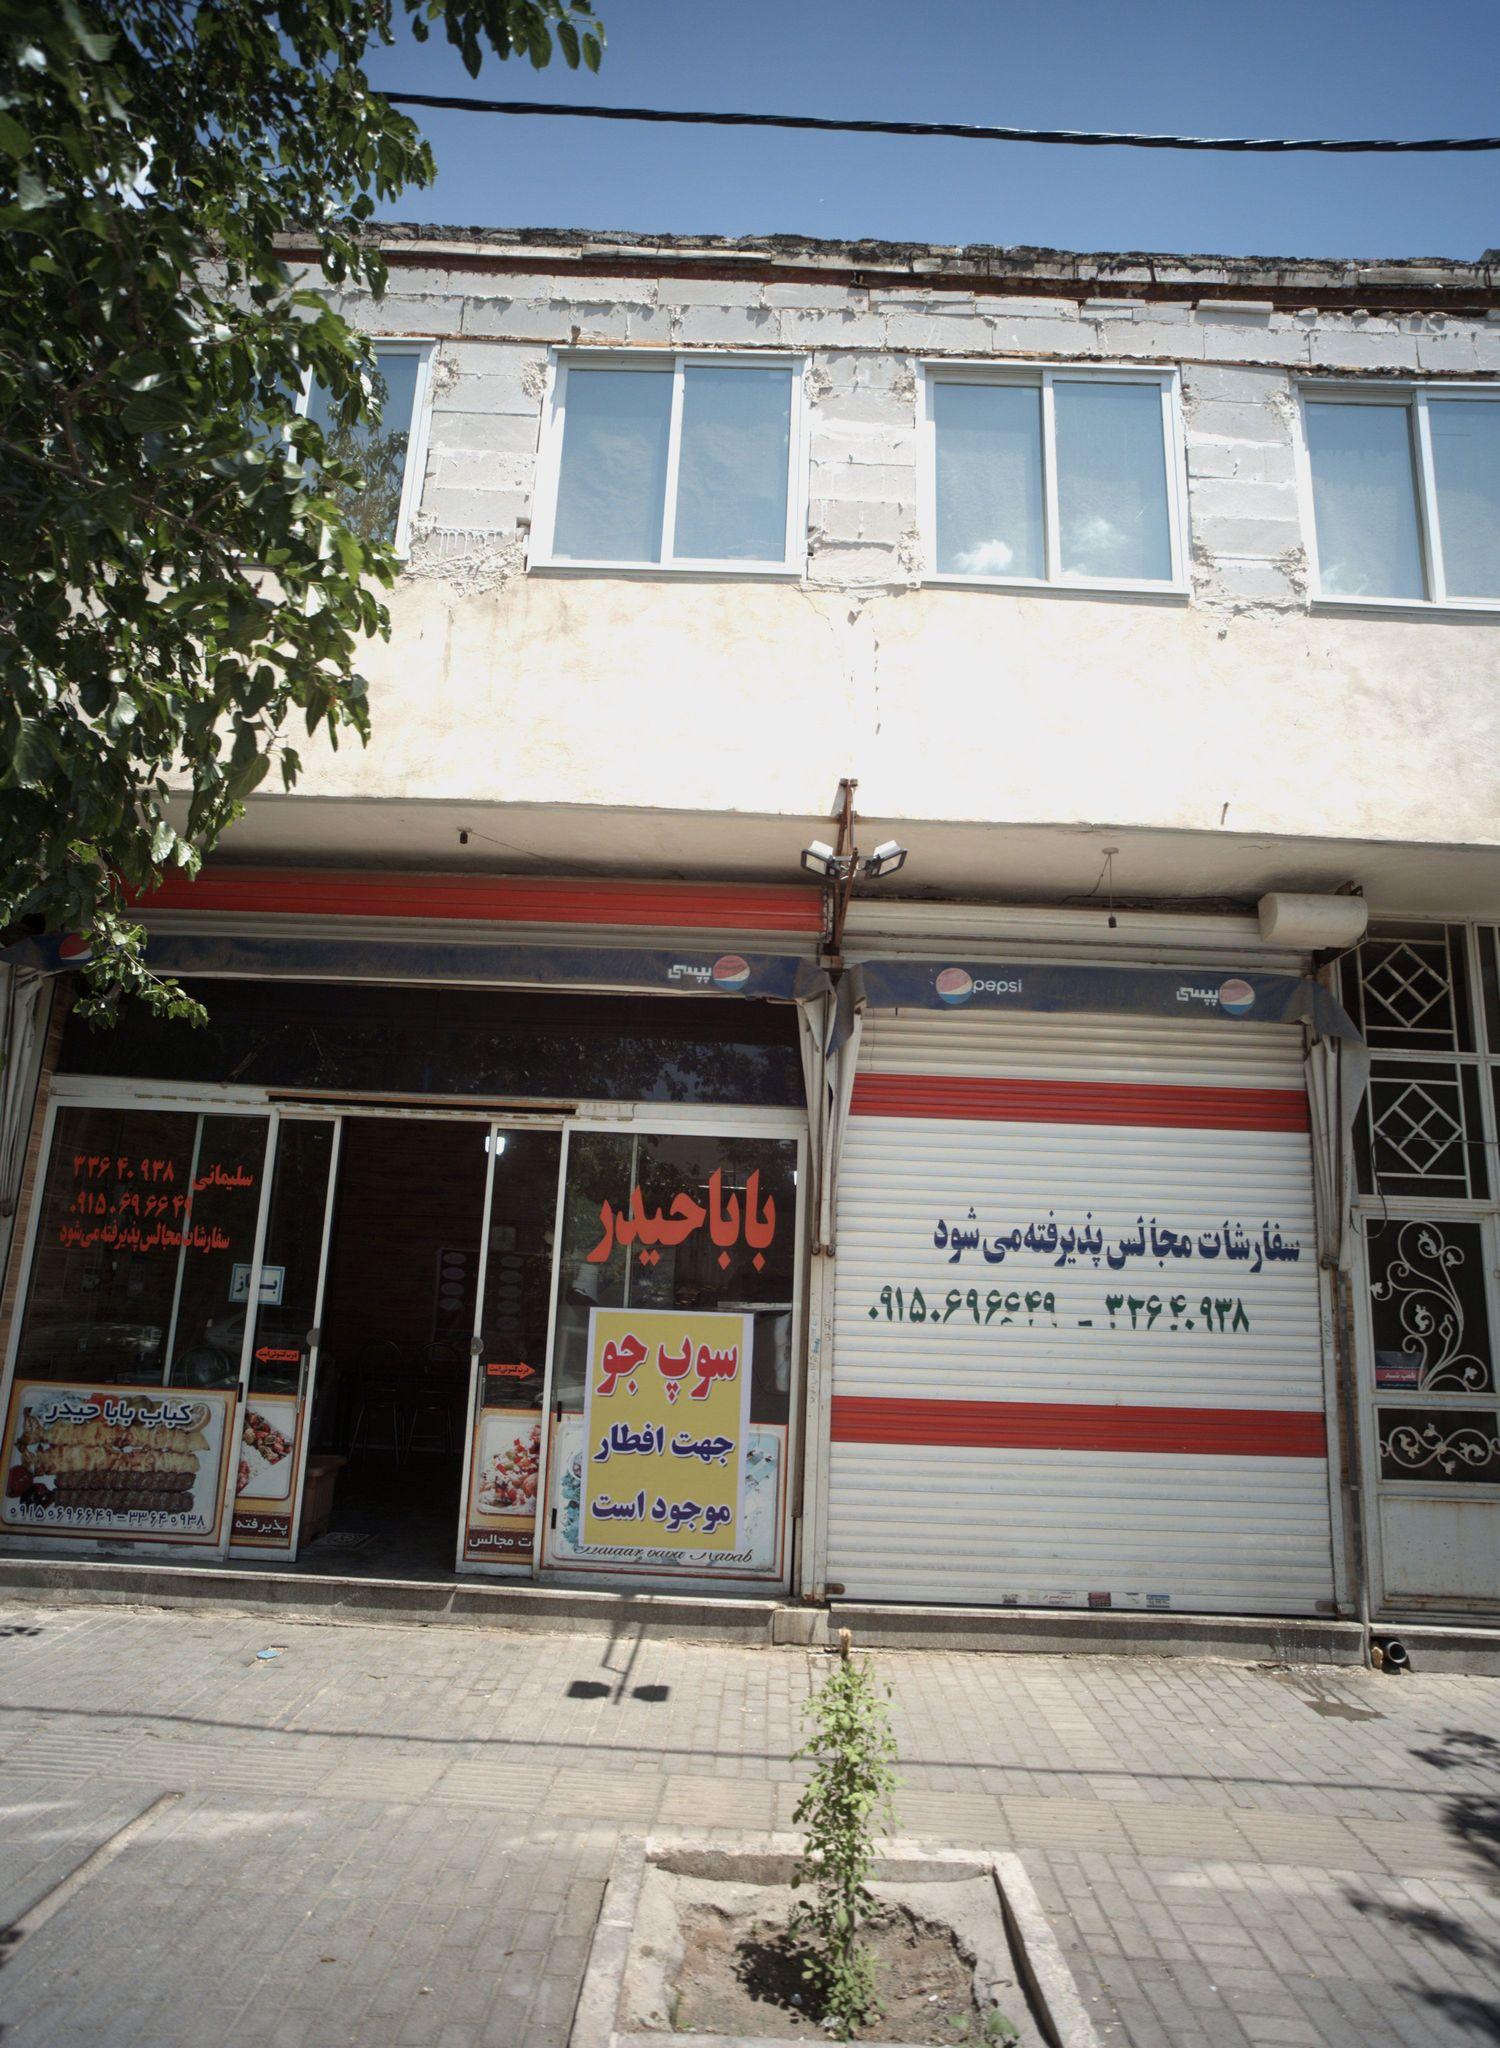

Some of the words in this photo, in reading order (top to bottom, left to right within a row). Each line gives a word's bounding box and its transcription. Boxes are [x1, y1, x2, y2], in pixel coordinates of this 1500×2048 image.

[668, 965, 711, 983] پپسی
[973, 979, 1022, 993] pepsi
[1176, 986, 1218, 1006] پپسی
[192, 1164, 254, 1191] سلیمانی
[586, 1184, 707, 1266] حیدر
[709, 1167, 776, 1272] بابا
[1024, 1210, 1103, 1268] پذیرفته
[1107, 1215, 1192, 1270] مجالس
[1198, 1219, 1300, 1273] سفارشات
[596, 1333, 649, 1396] جو
[658, 1335, 738, 1404] سوپ
[46, 1402, 99, 1422] حیدر
[104, 1401, 137, 1426] بابا
[140, 1403, 193, 1427] کباب
[593, 1423, 665, 1463] افطار
[671, 1433, 735, 1465] جهت
[592, 1490, 645, 1521] است
[651, 1496, 732, 1533] موجود
[235, 1518, 288, 1535] پذیرفته
[469, 1534, 514, 1549] مجالس
